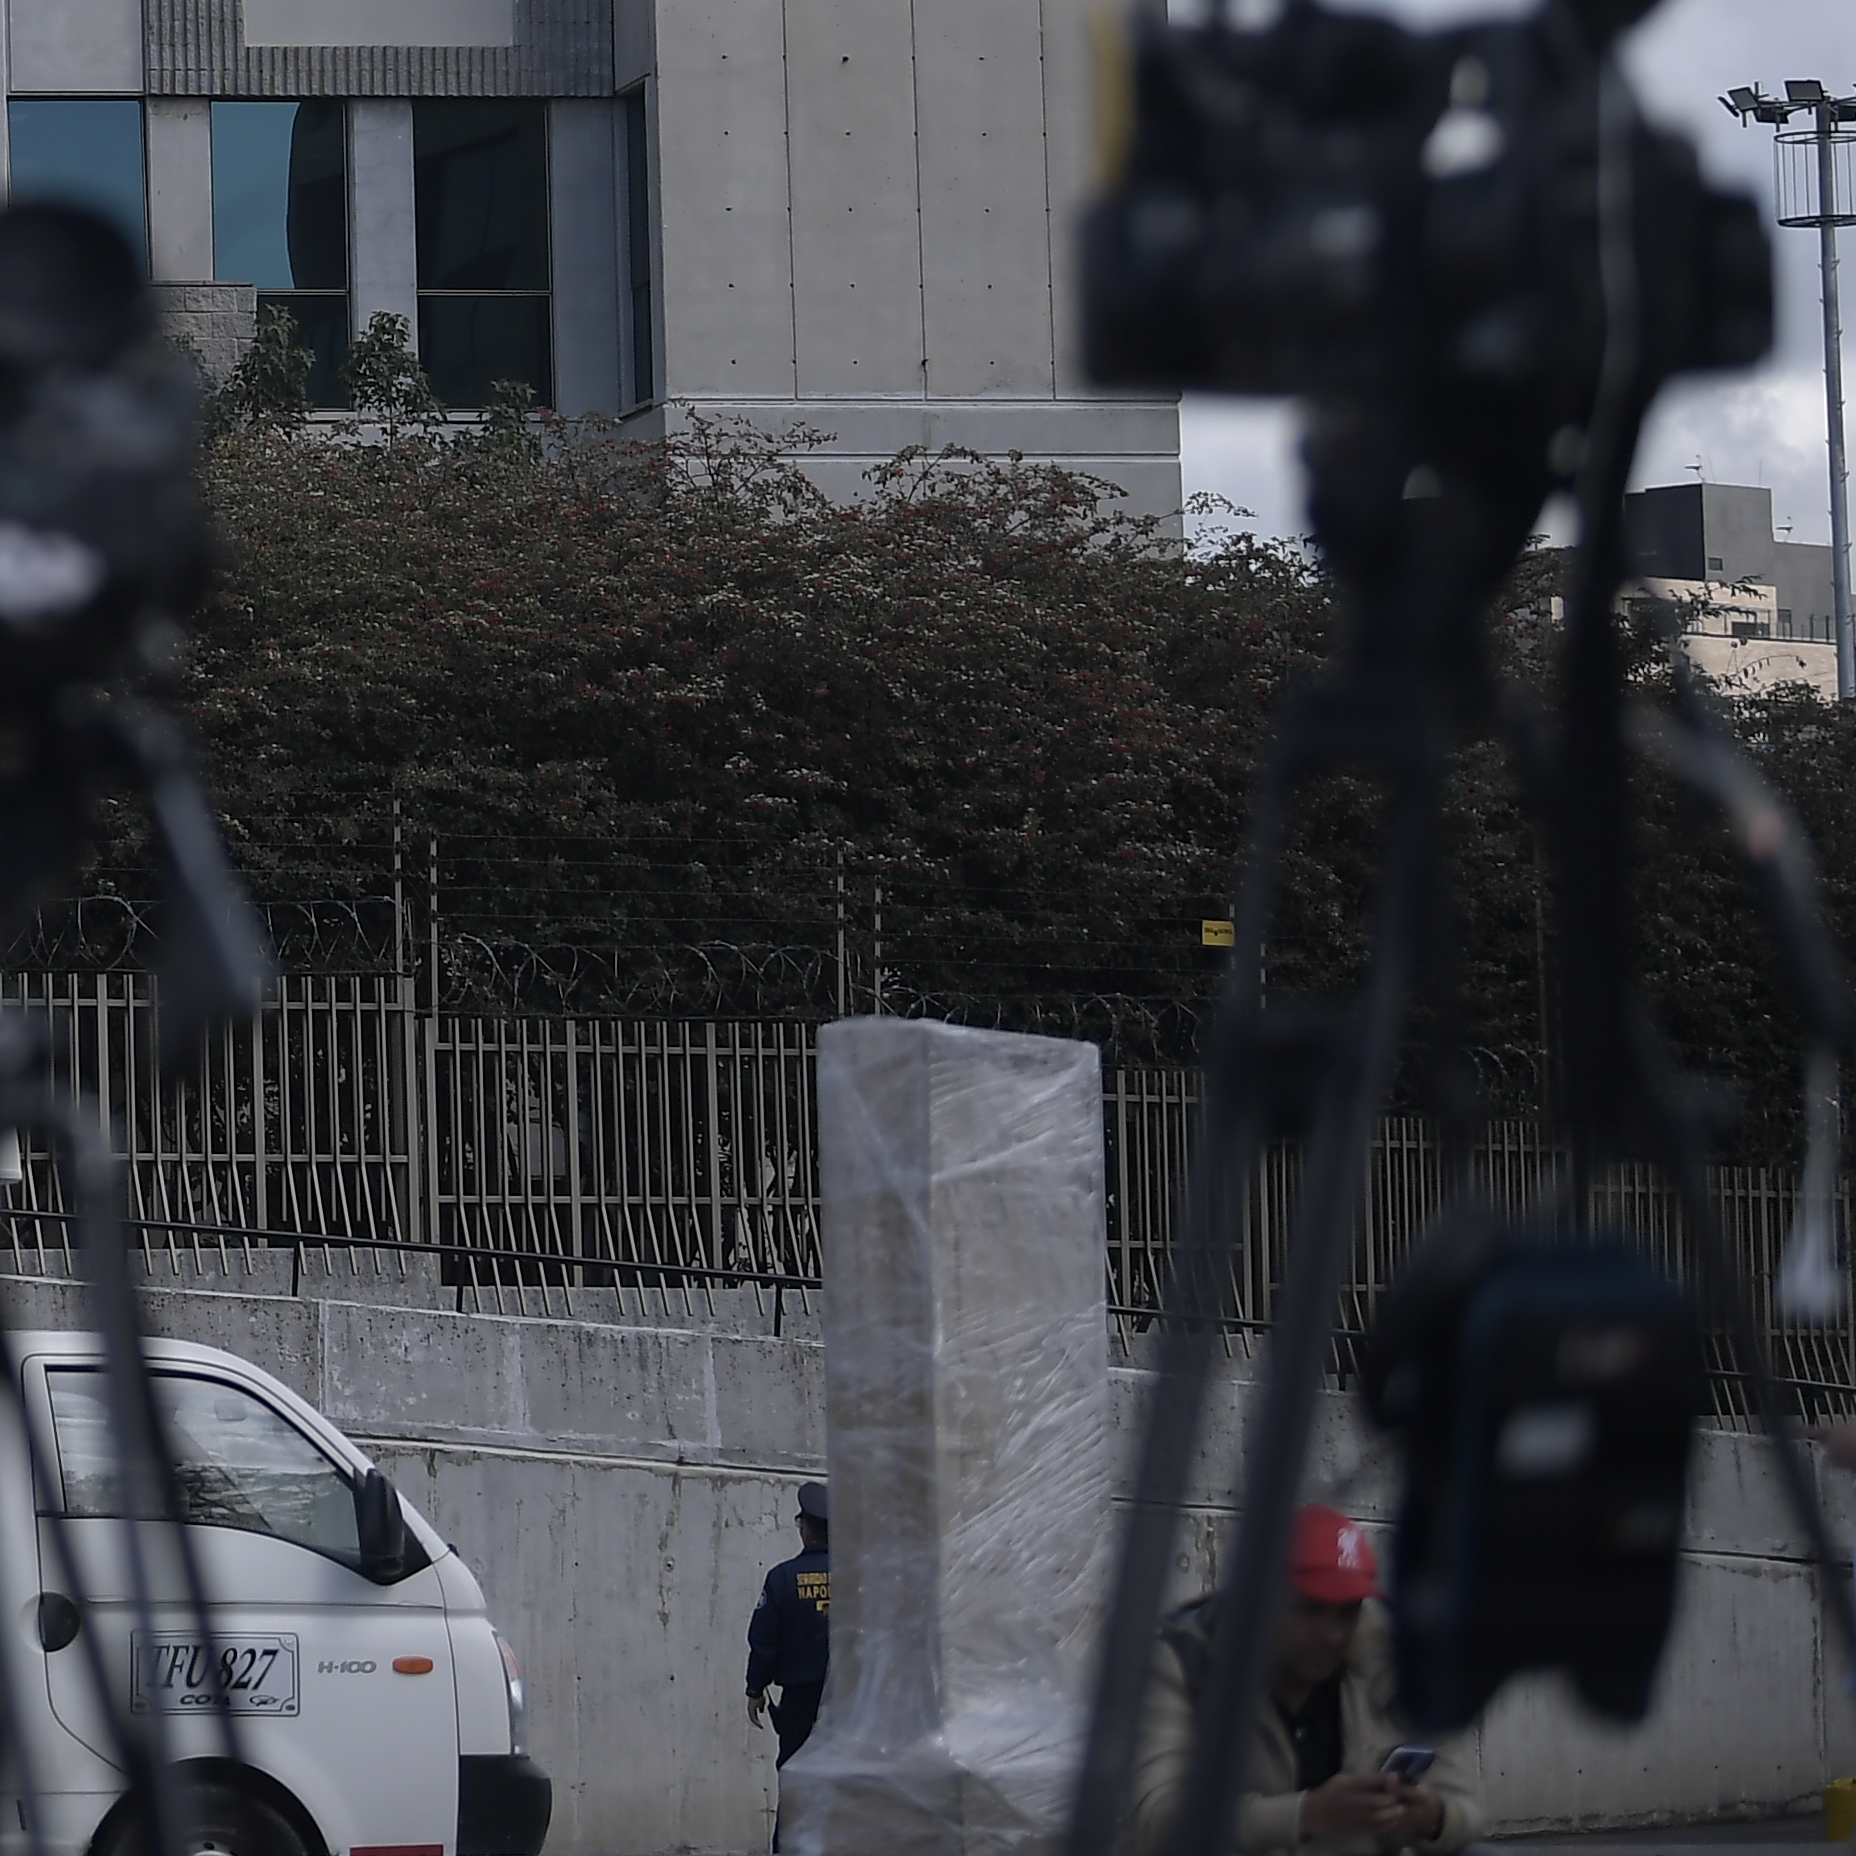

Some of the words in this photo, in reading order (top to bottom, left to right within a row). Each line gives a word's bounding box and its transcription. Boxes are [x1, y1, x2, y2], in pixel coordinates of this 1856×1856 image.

[145, 1644, 213, 1689] TFU
[217, 1647, 279, 1690] 827
[317, 1660, 377, 1674] H-100
[179, 1694, 231, 1706] COA
